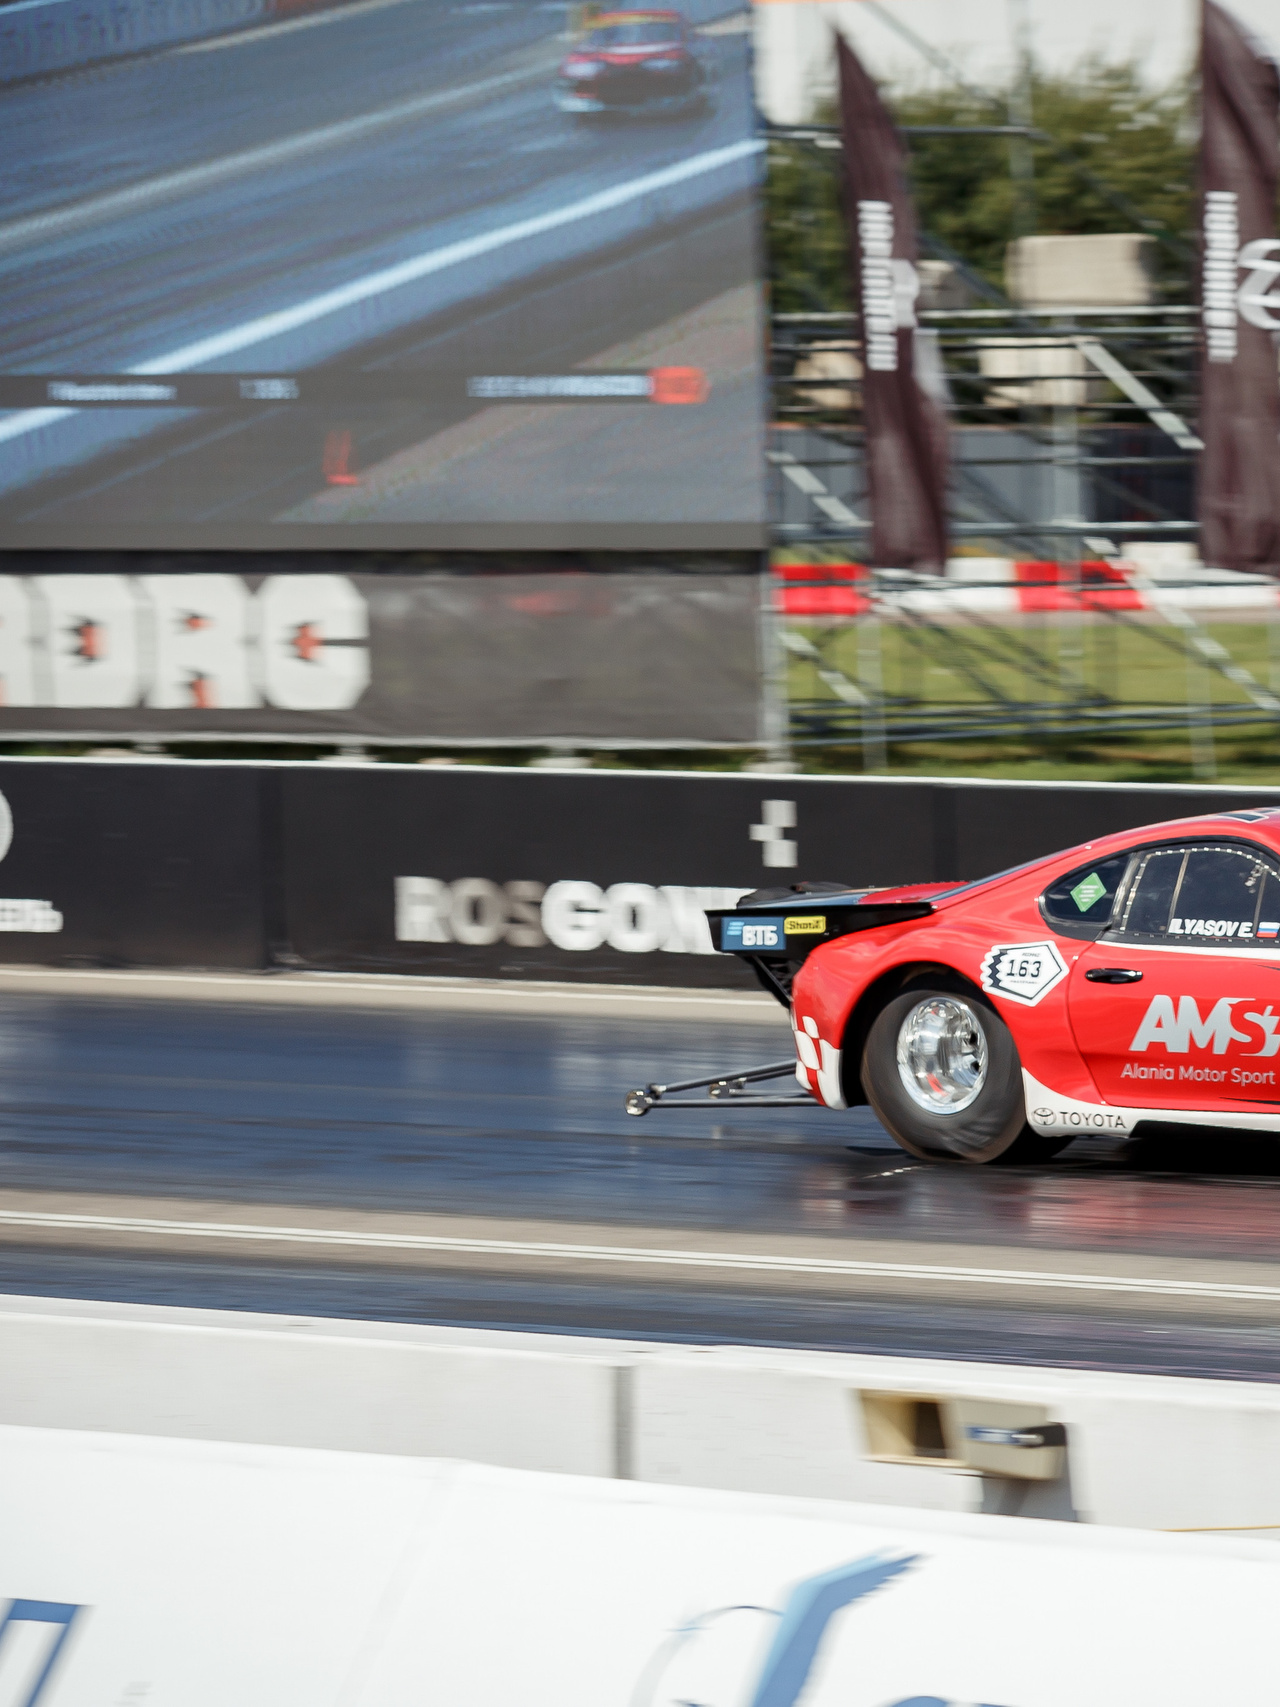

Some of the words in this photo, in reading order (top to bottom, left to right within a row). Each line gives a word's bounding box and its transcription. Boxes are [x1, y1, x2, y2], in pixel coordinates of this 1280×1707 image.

[742, 925, 778, 946] ВТБ
[1168, 918, 1239, 937] ILYASOV
[1006, 959, 1042, 978] 163
[1128, 995, 1279, 1057] AMS
[1120, 1063, 1174, 1080] Alania
[1178, 1065, 1227, 1082] Motor
[1231, 1067, 1276, 1087] Sport
[1060, 1111, 1127, 1128] TOYOTA
